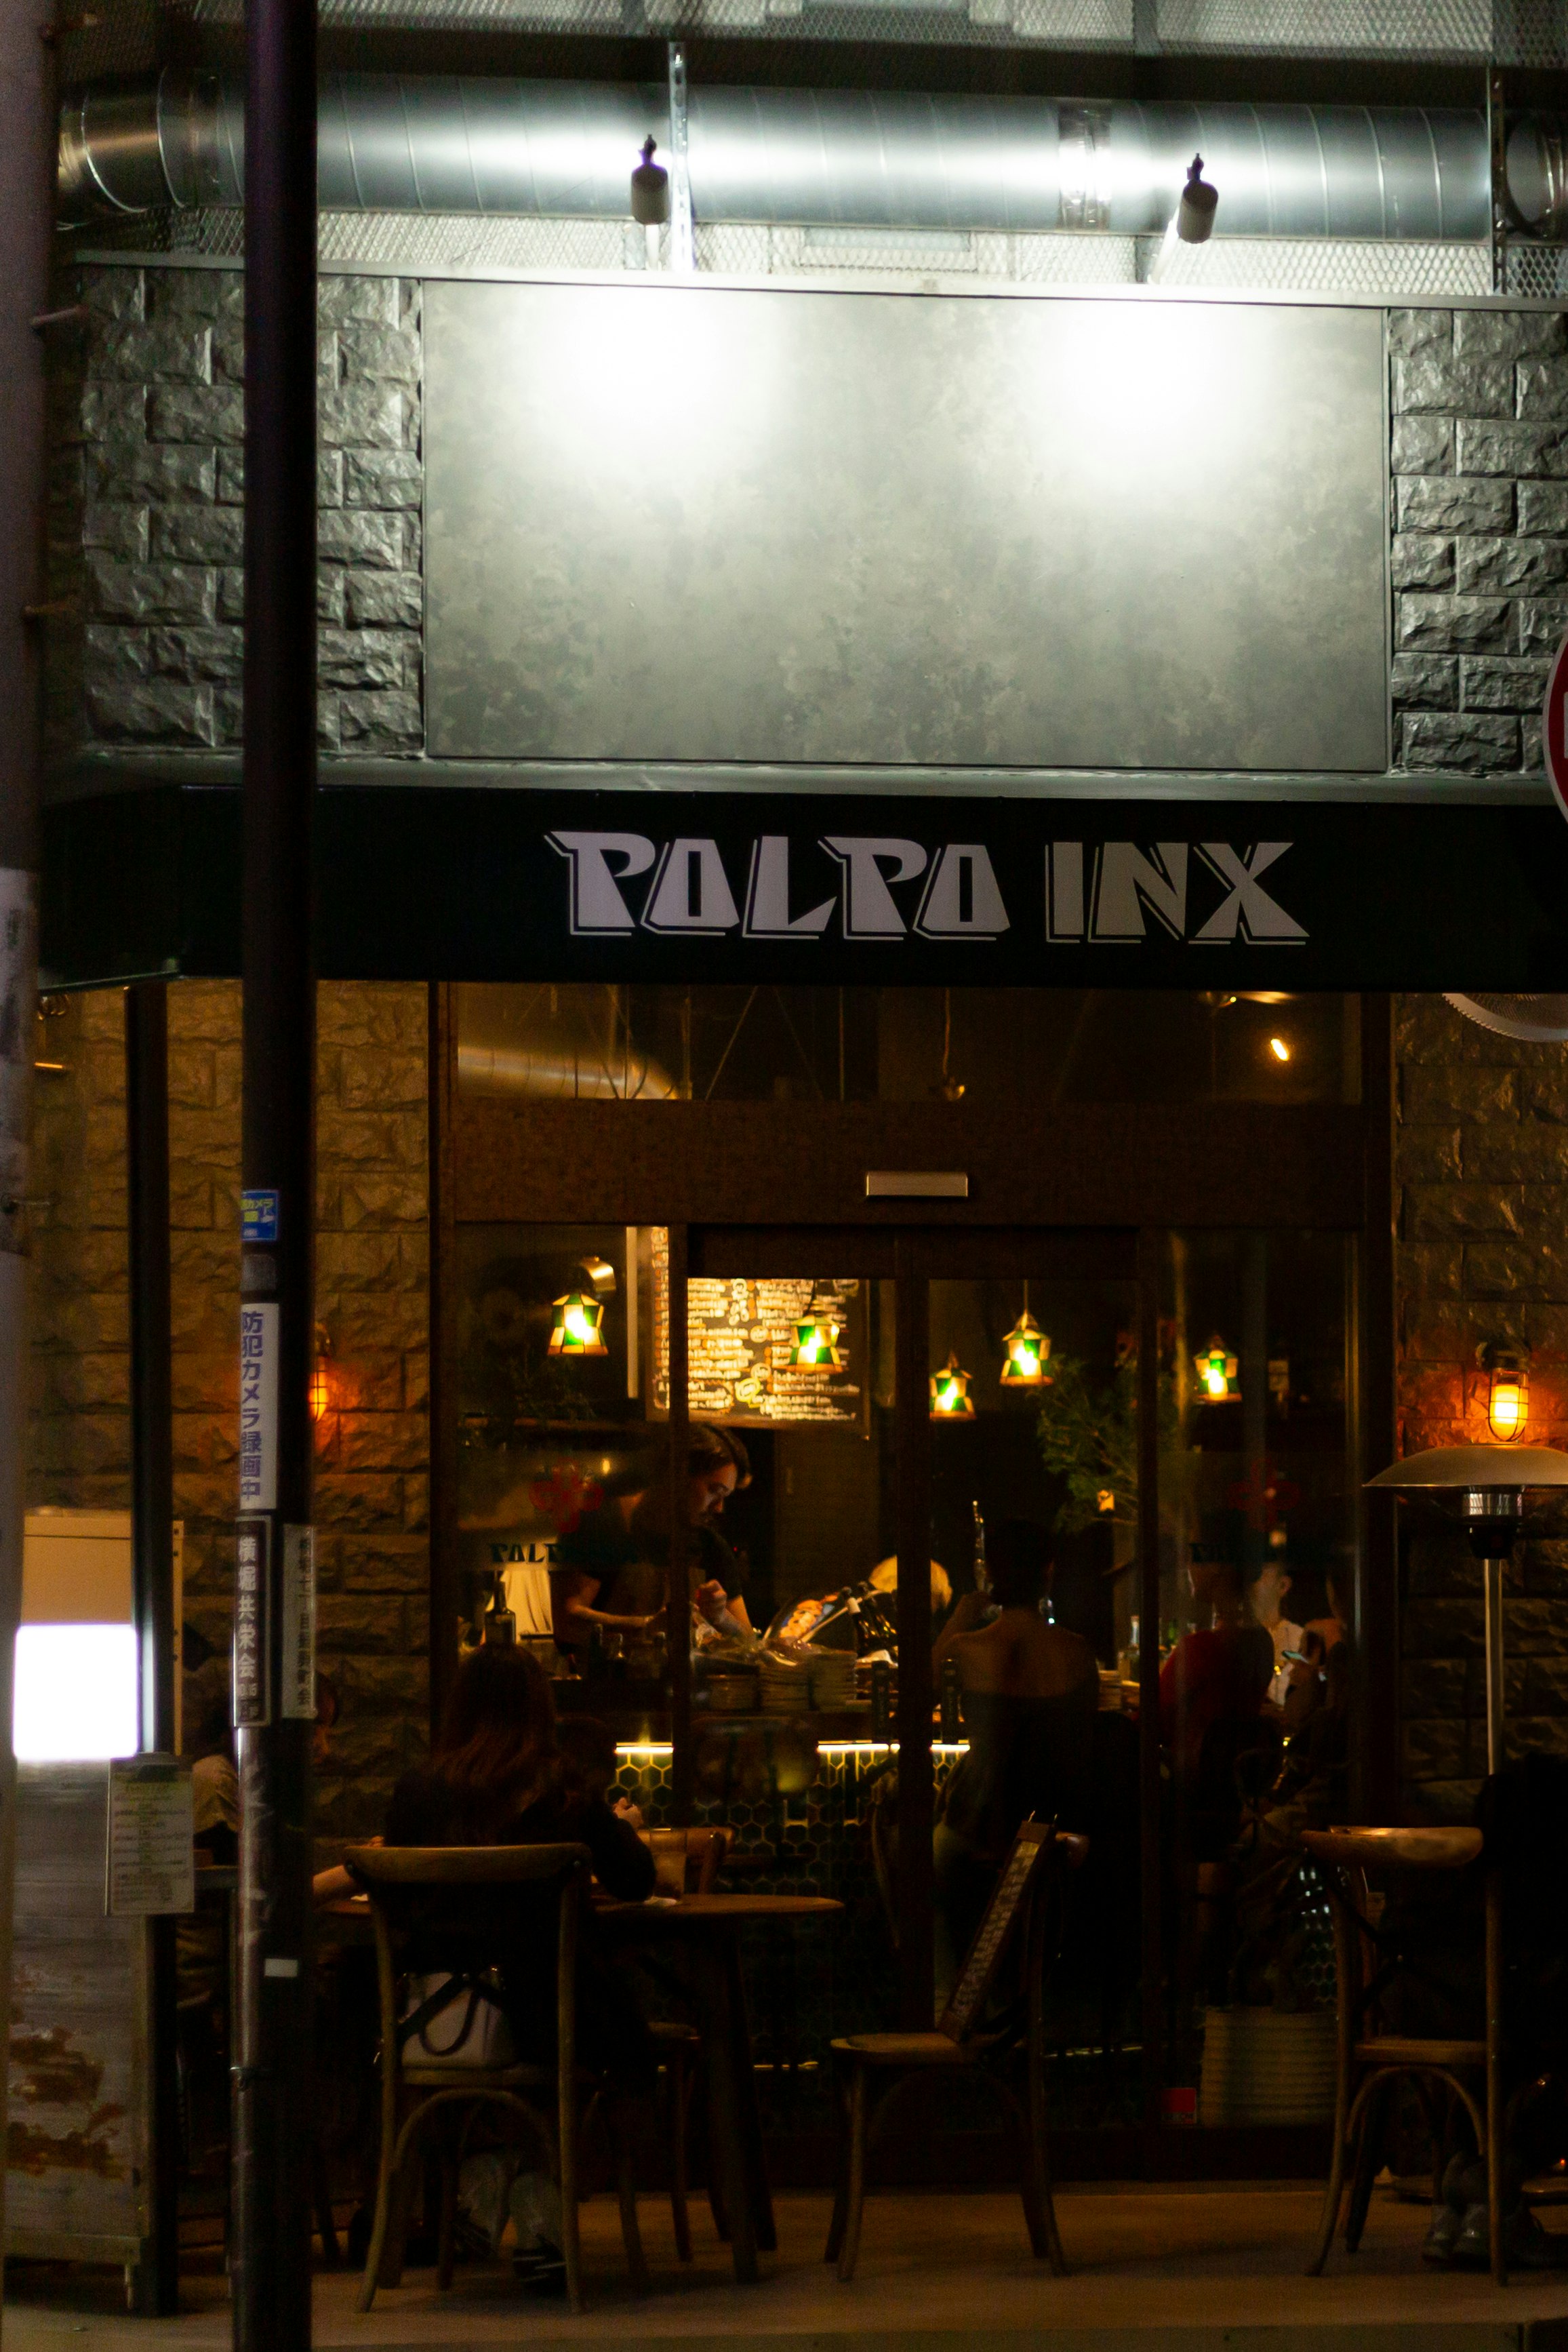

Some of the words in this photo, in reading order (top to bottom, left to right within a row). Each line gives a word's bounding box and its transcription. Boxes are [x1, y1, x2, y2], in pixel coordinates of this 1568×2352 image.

[544, 831, 1010, 941] POLPO
[1045, 841, 1310, 944] INX
[241, 1311, 264, 1500] 防犯カメラ録画中
